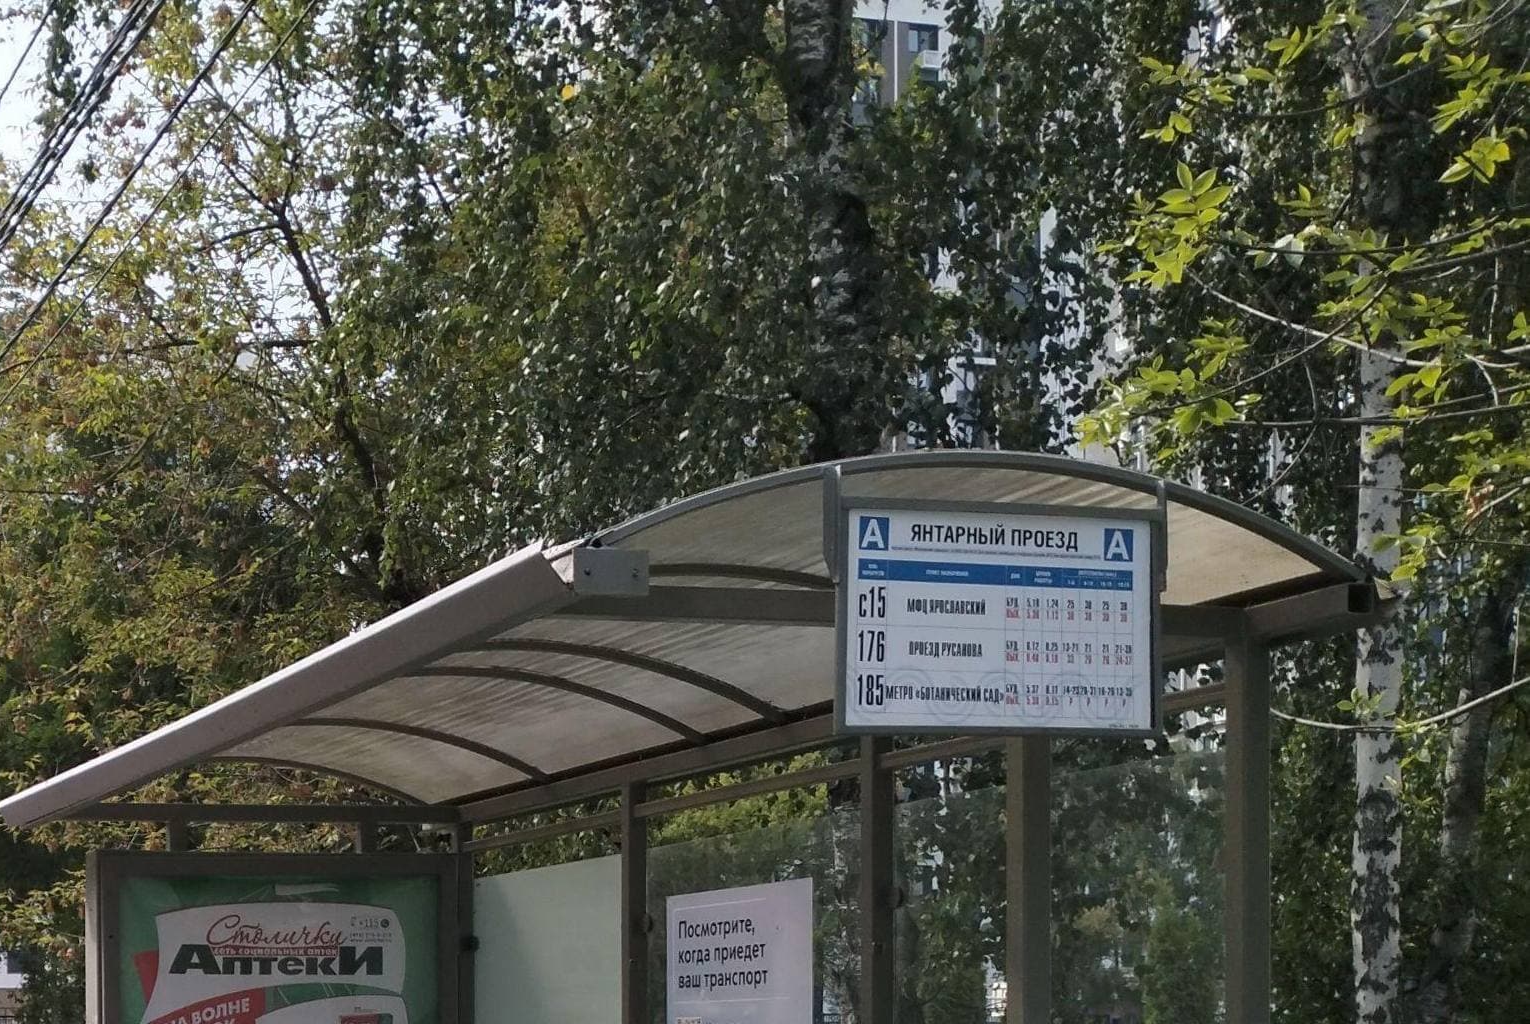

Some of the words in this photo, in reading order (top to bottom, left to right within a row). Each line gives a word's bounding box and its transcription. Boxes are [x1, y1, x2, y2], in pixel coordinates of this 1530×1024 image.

[860, 518, 886, 549] А
[910, 523, 1006, 545] ЯНТАРНЫЙ
[1011, 528, 1079, 552] ПРОЕЗД
[1105, 529, 1130, 561] А
[907, 598, 927, 614] МФЦ
[929, 598, 986, 615] ЯРОСЛАВСКИЙ
[858, 630, 885, 662] 176
[909, 641, 939, 658] ПРОЕЗД
[941, 642, 982, 657] РУСАНОВА
[857, 674, 884, 705] 185
[886, 685, 913, 700] МЕТРО
[915, 685, 982, 702] «БОТАНИЧЕСКИЙ
[983, 688, 1004, 704] САД»
[206, 914, 348, 946] Столички
[678, 918, 755, 939] Посмотрите,
[678, 948, 711, 965] когда
[714, 944, 766, 964] приедет
[678, 975, 701, 989] ваш
[704, 970, 768, 992] транспорт
